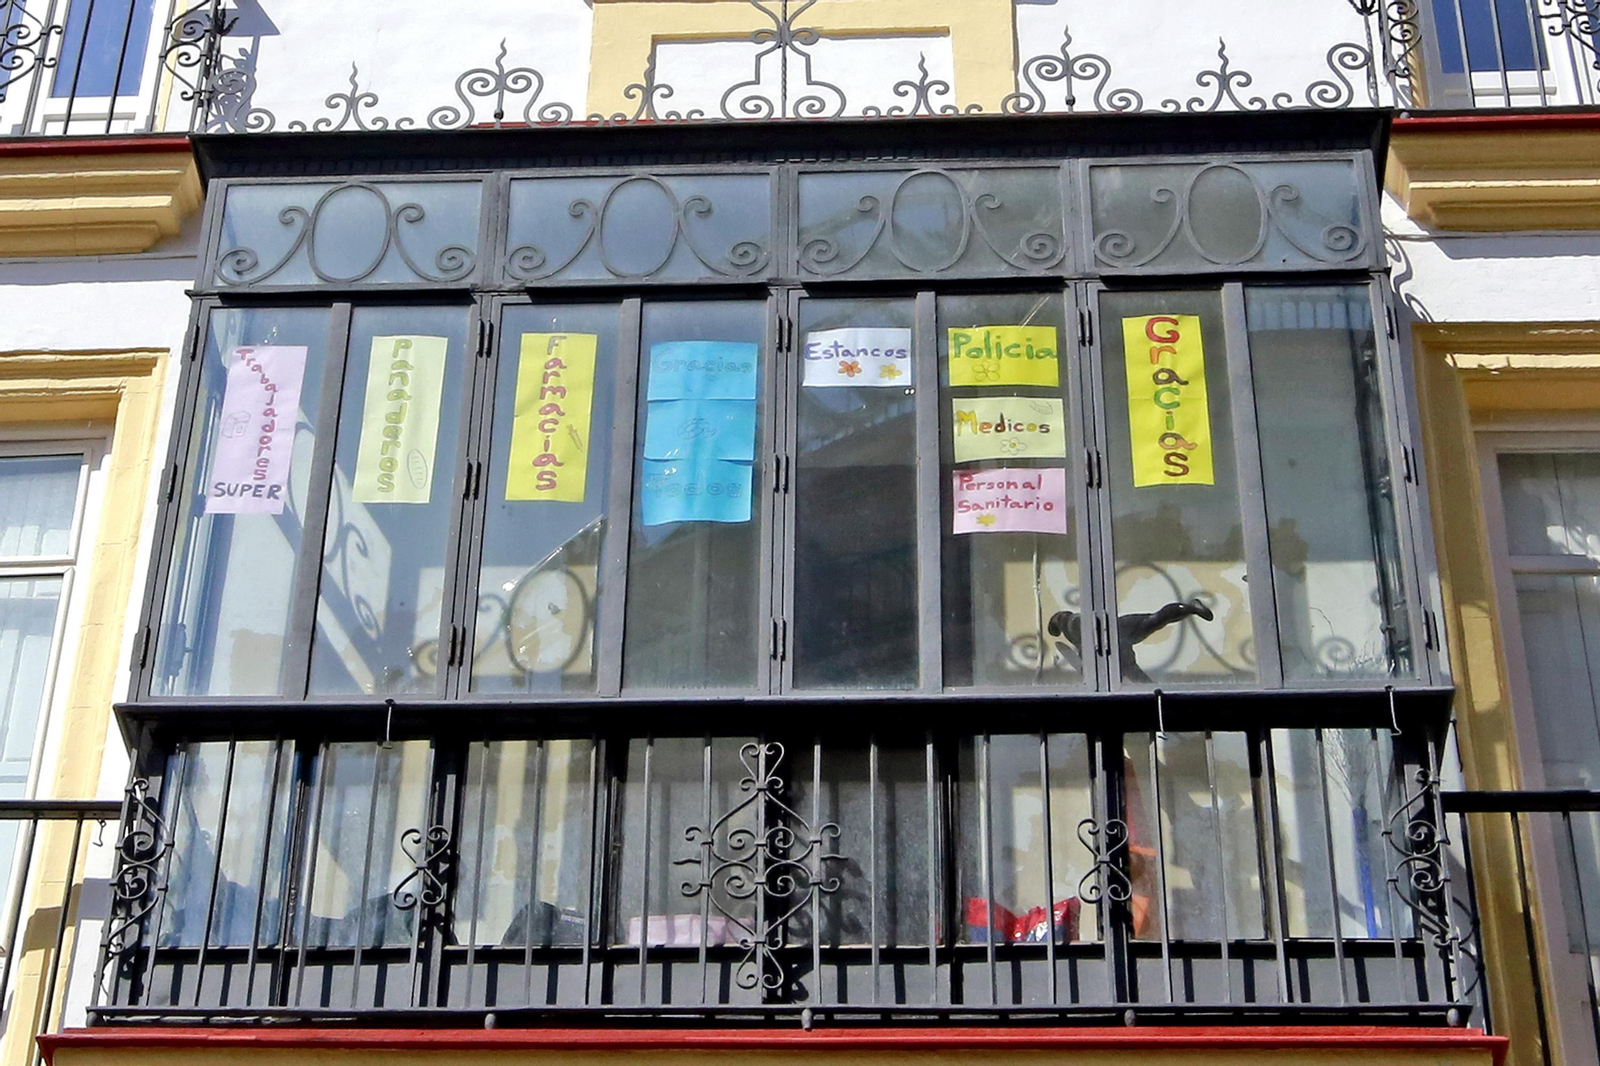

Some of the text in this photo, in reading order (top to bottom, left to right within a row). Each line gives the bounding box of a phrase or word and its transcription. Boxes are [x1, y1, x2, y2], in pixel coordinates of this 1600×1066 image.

[805, 340, 908, 361] Estancos
[953, 330, 1058, 360] Policia
[1145, 316, 1198, 477] Gracias
[236, 349, 278, 480] Trabajadores
[377, 339, 414, 493] Panaderos
[532, 336, 567, 490] Farmacias
[956, 410, 1050, 437] Medicos
[214, 482, 282, 499] SUPER
[958, 474, 1043, 491] Personal
